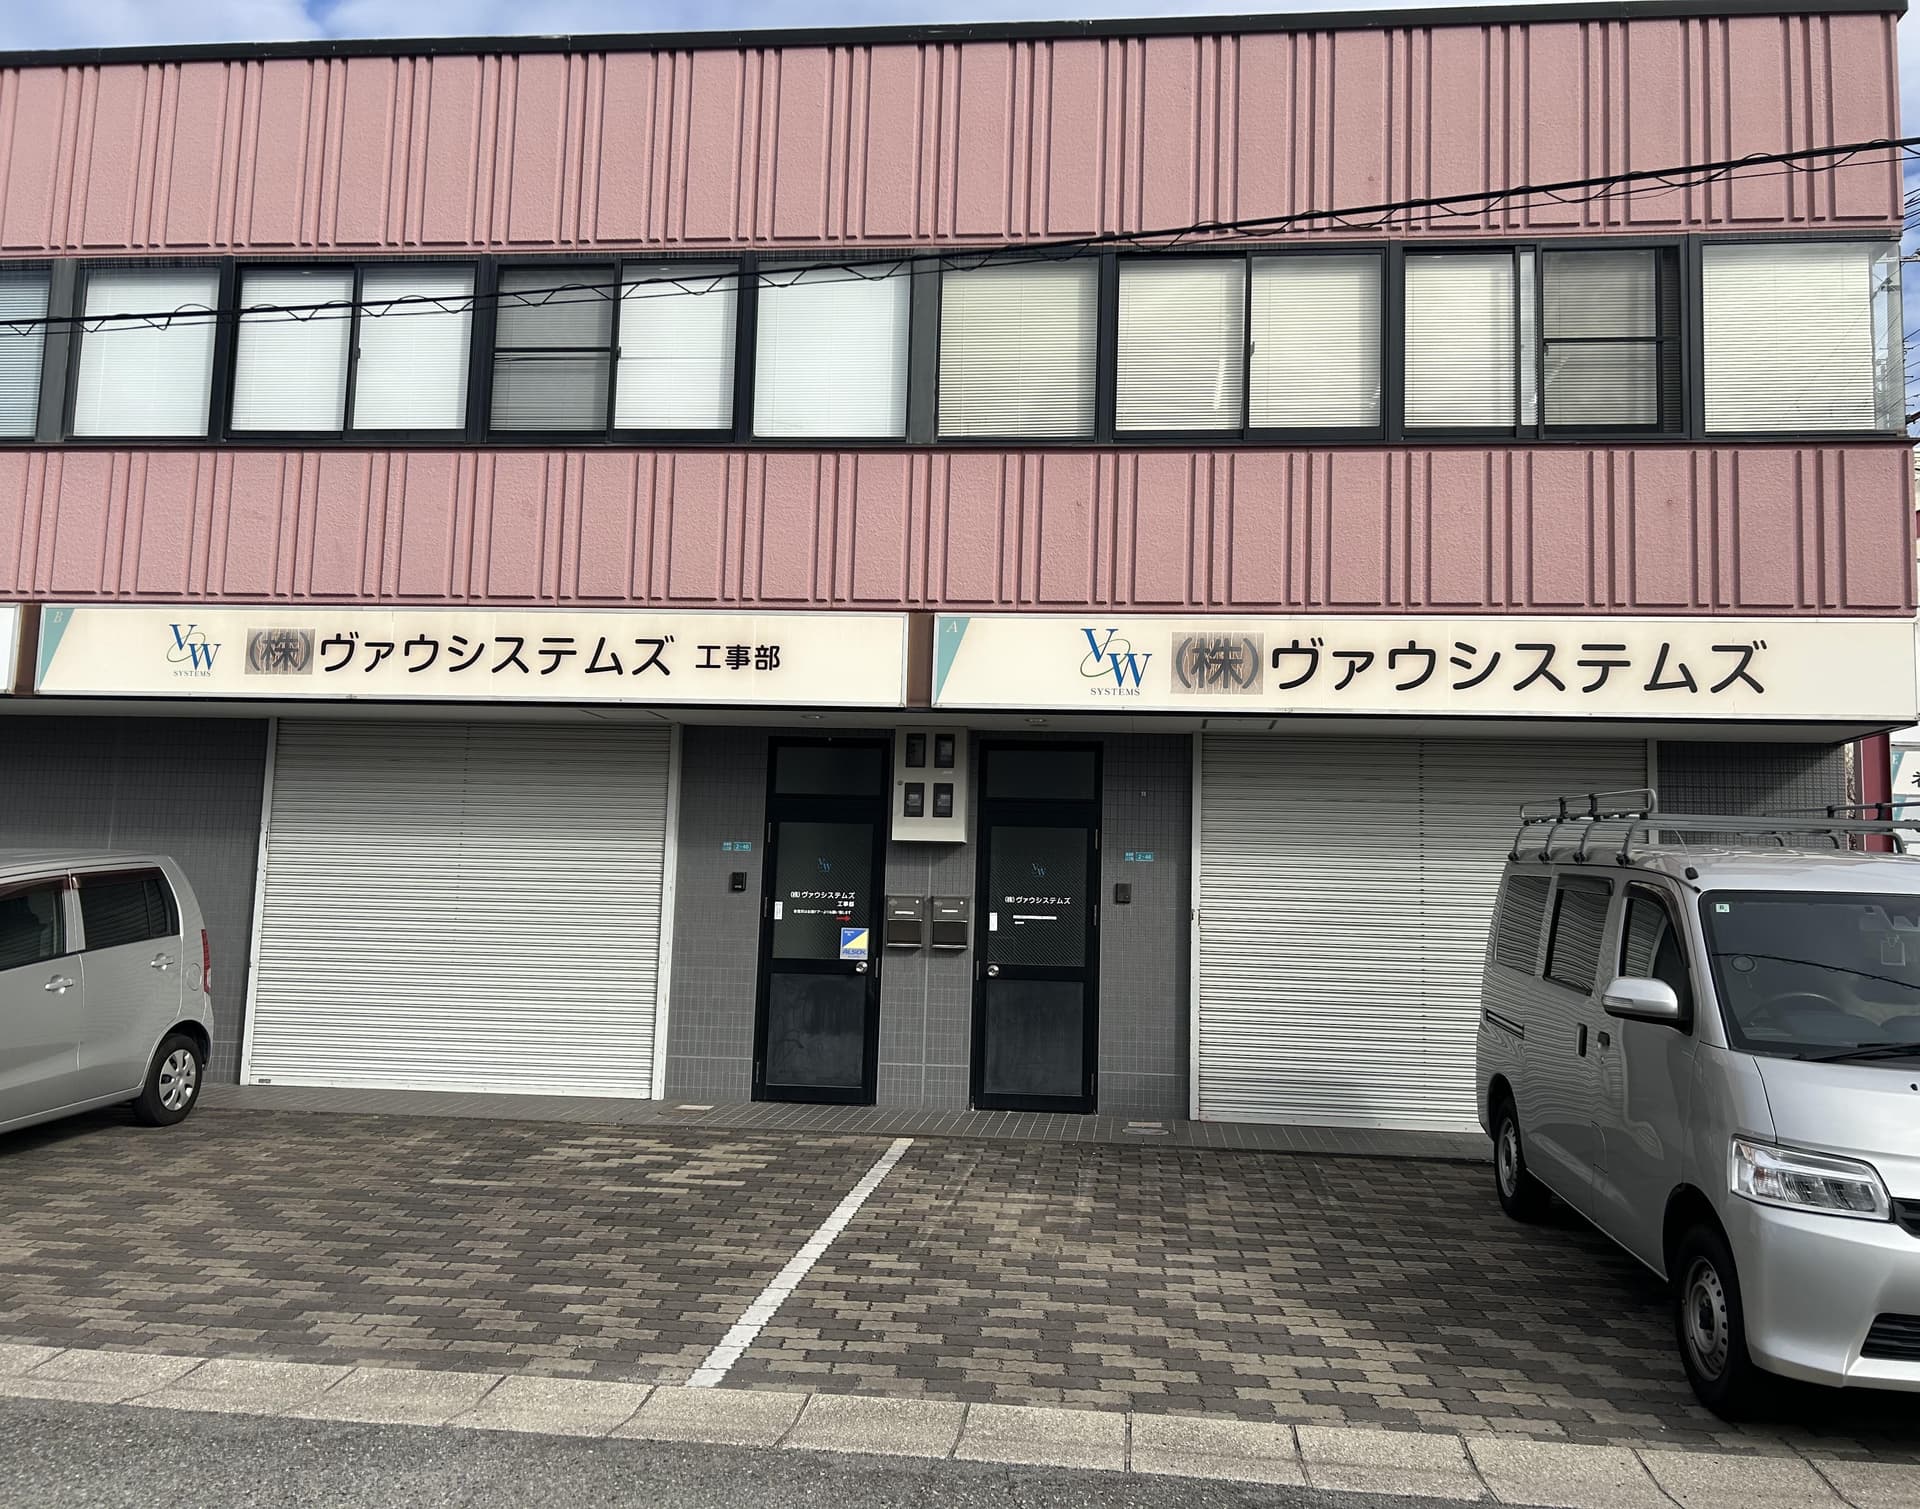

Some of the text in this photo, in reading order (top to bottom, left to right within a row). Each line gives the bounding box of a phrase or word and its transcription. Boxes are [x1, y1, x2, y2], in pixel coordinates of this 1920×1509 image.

[946, 619, 958, 633] A
[695, 644, 781, 672] 工事部
[173, 670, 212, 678] SYSTEMS
[1090, 687, 1141, 697] SYSTEMS
